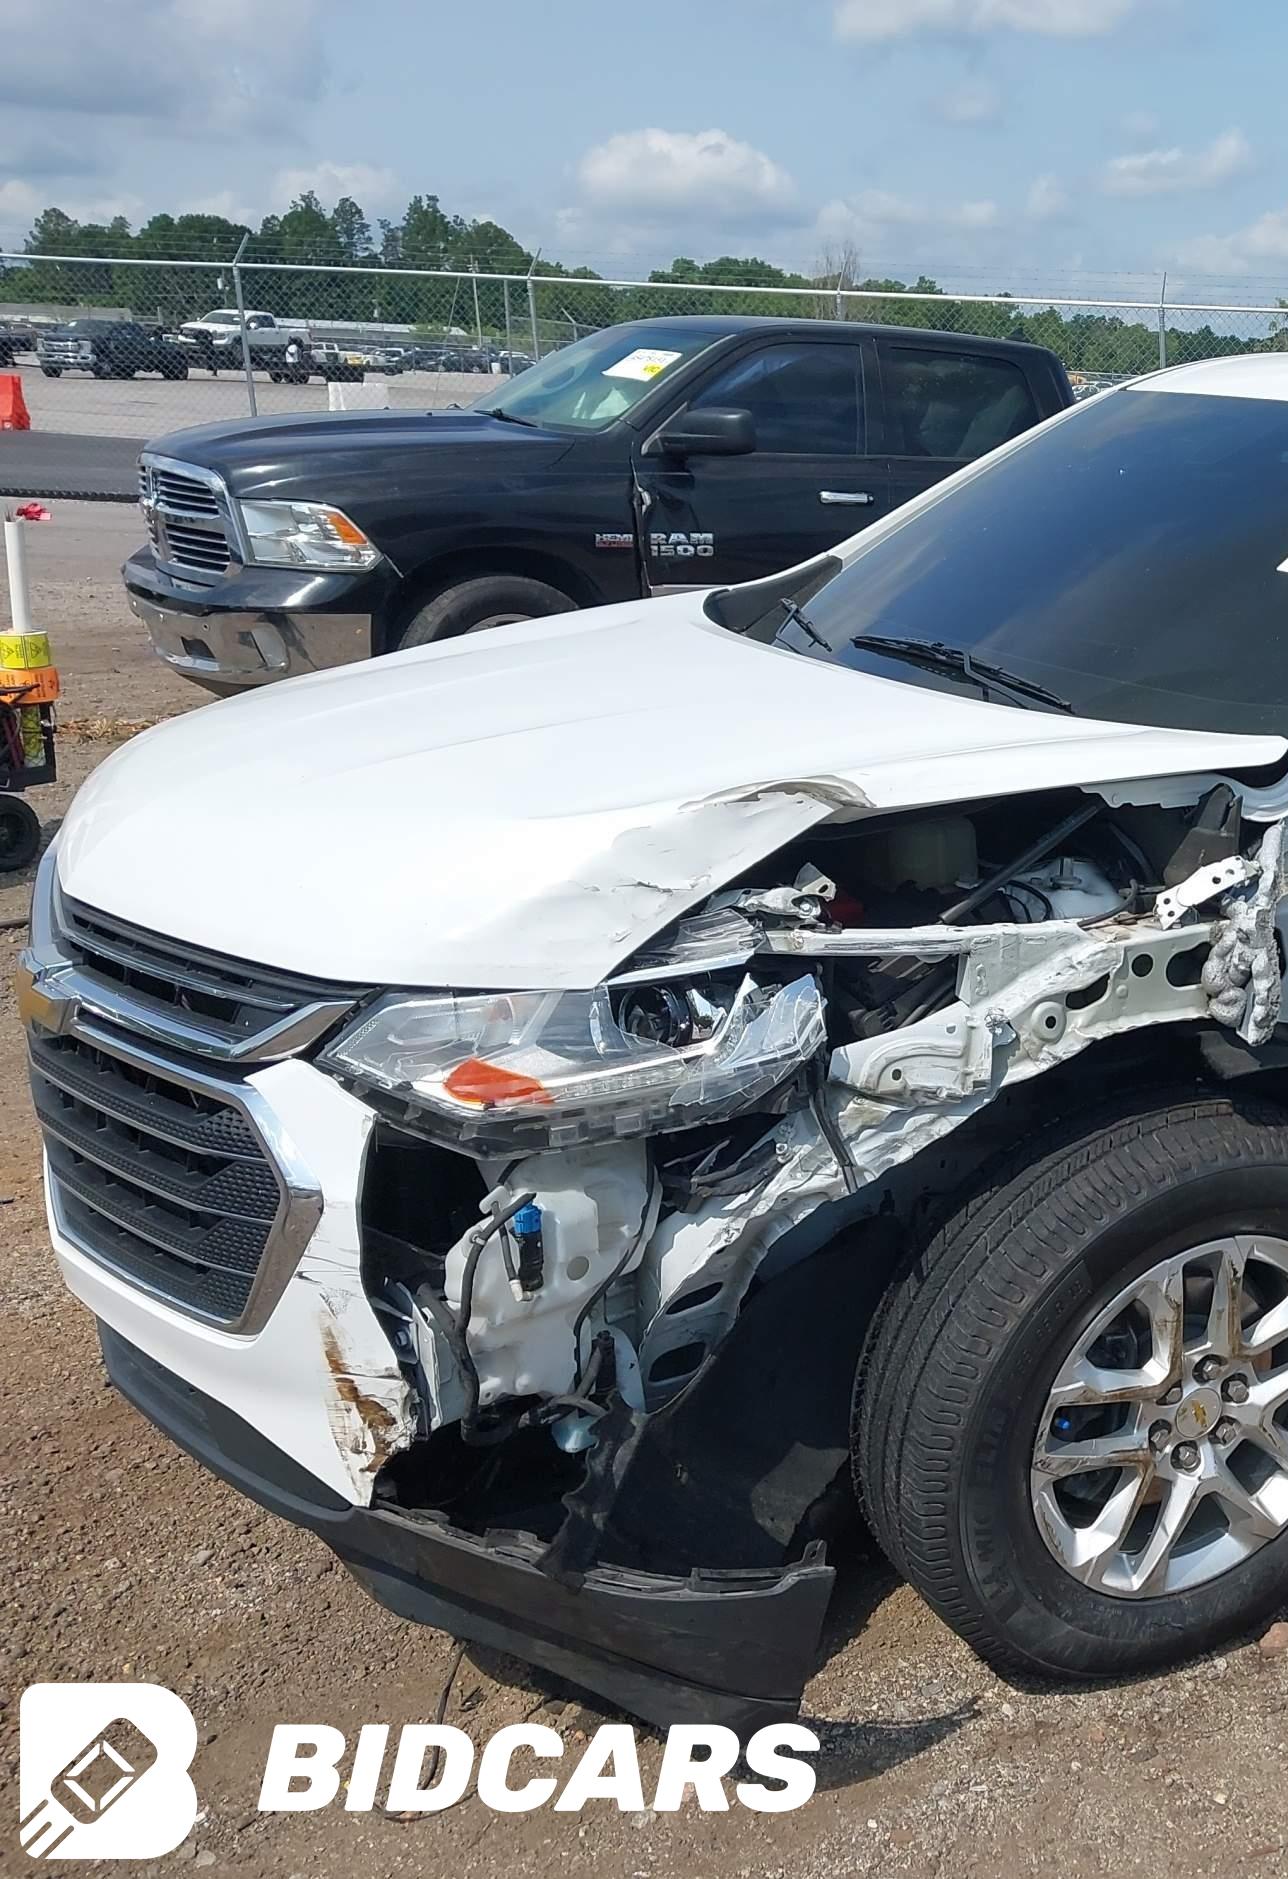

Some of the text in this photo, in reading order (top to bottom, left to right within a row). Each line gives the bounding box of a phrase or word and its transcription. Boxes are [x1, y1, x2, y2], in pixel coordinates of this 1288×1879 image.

[595, 533, 633, 542] HEMI
[650, 532, 714, 545] RAM
[650, 544, 714, 557] 1500
